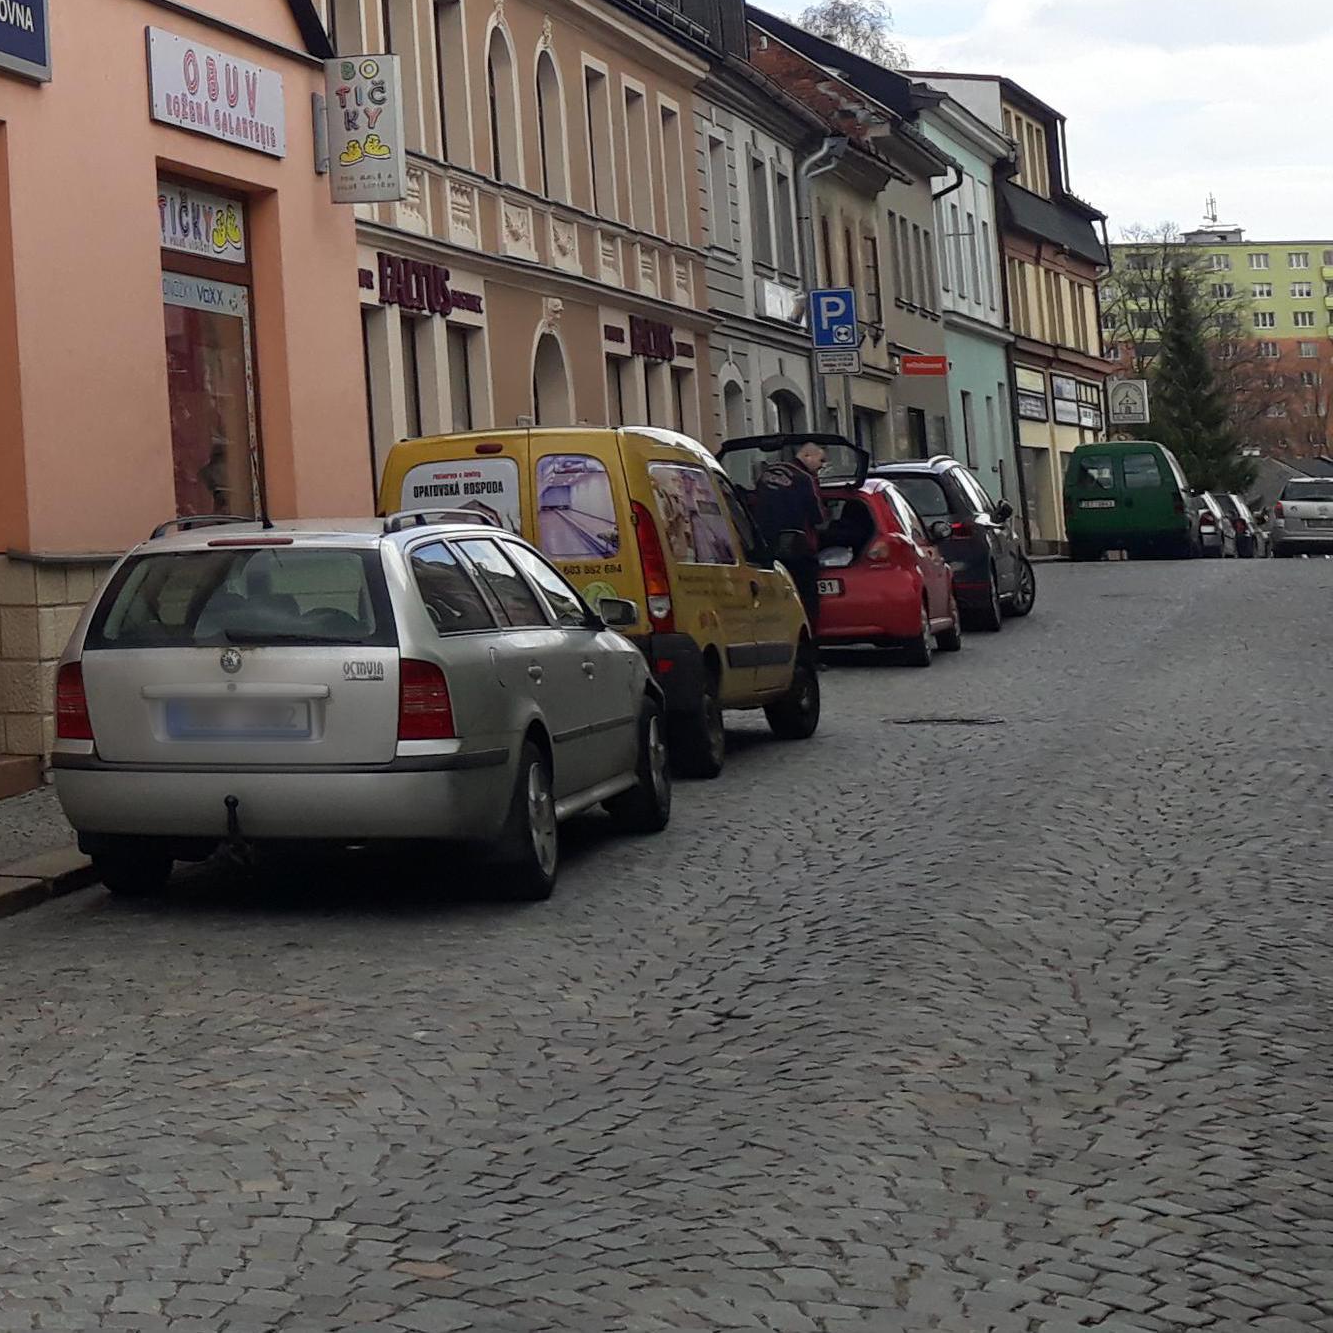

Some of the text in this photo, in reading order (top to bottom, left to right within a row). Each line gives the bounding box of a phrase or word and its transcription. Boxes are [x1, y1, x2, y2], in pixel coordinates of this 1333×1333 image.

[184, 49, 257, 117] OBUV
[341, 59, 379, 80] BO
[336, 80, 387, 108] TIČ
[344, 107, 382, 131] KY
[820, 296, 846, 330] P
